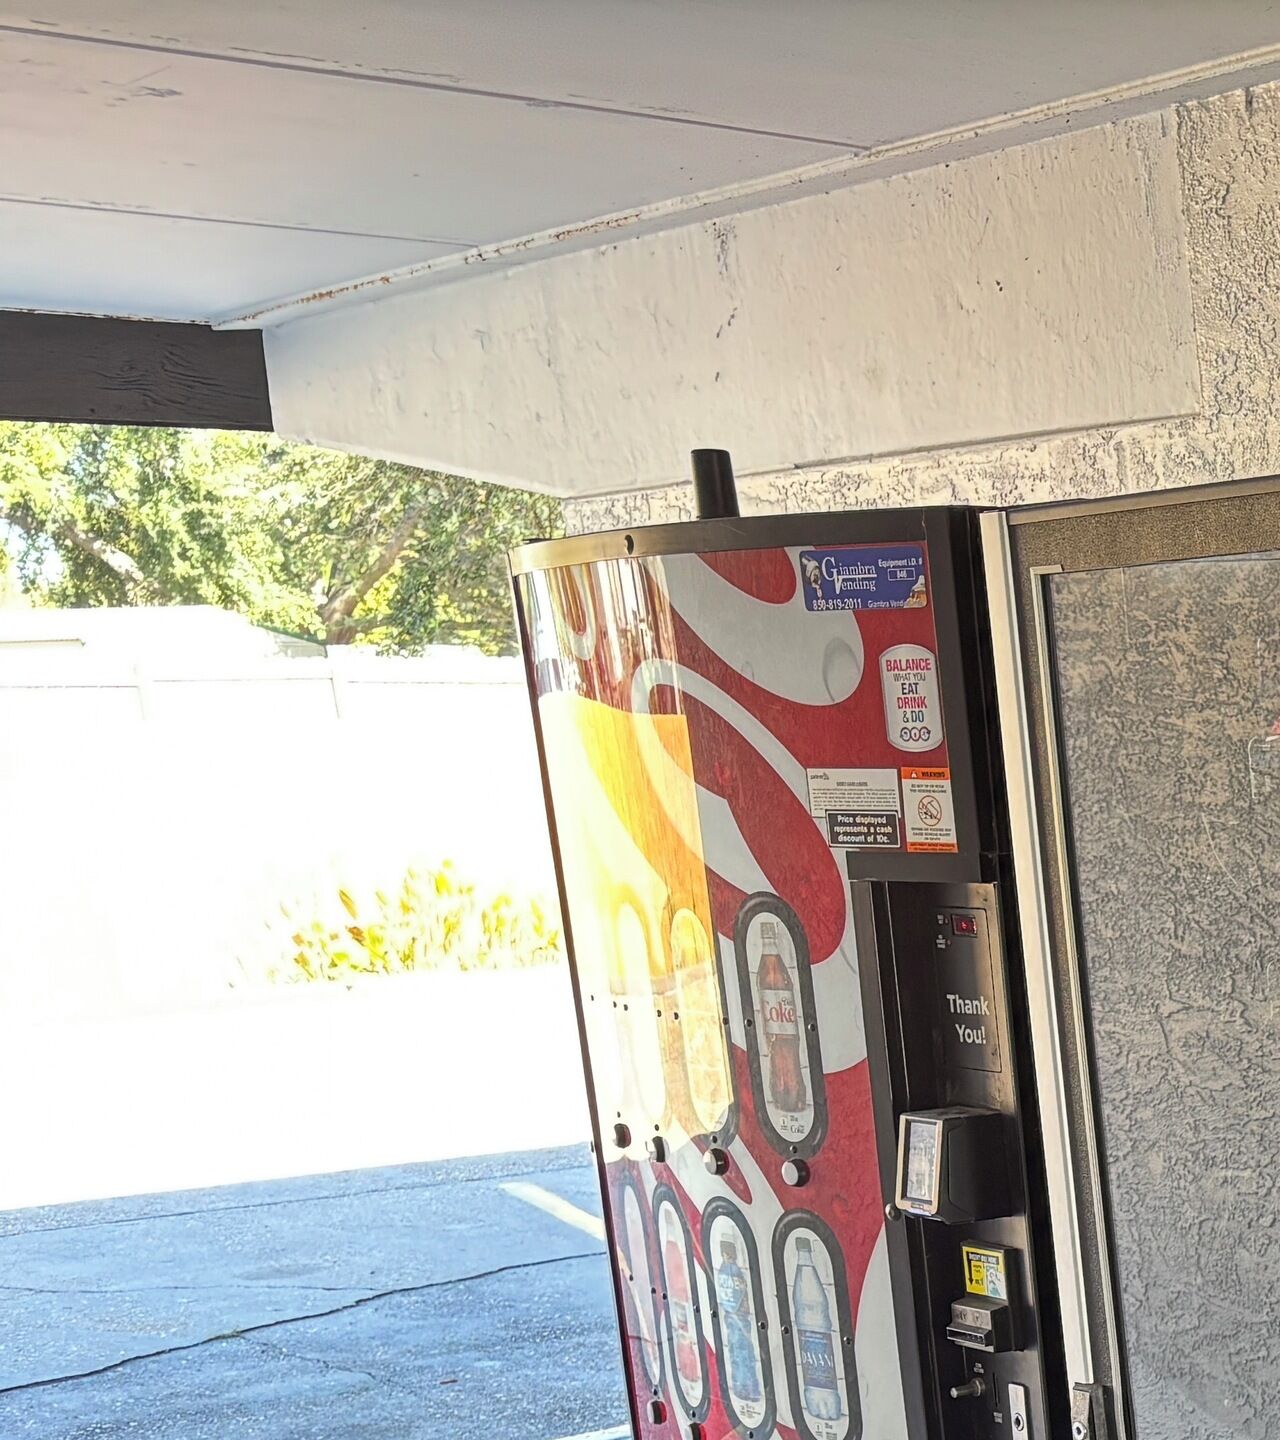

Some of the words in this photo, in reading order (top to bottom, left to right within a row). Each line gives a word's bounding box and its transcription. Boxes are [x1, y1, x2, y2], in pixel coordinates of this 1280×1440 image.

[821, 557, 876, 580] Giambra
[833, 575, 876, 595] Vending
[812, 598, 862, 610] 850-819-2011
[886, 658, 932, 672] BALANCE
[893, 673, 911, 682] WHAT
[913, 672, 926, 681] YOU
[901, 683, 919, 695] EAT
[896, 696, 928, 709] DRINK
[902, 711, 909, 723] &
[911, 710, 925, 723] DO
[837, 815, 854, 824] Price
[855, 816, 887, 826] displayed
[833, 826, 868, 835] represents
[876, 826, 893, 834] cash
[837, 834, 866, 843] discount
[867, 834, 875, 842] of
[946, 994, 991, 1016] Thank
[955, 1023, 987, 1045] You!
